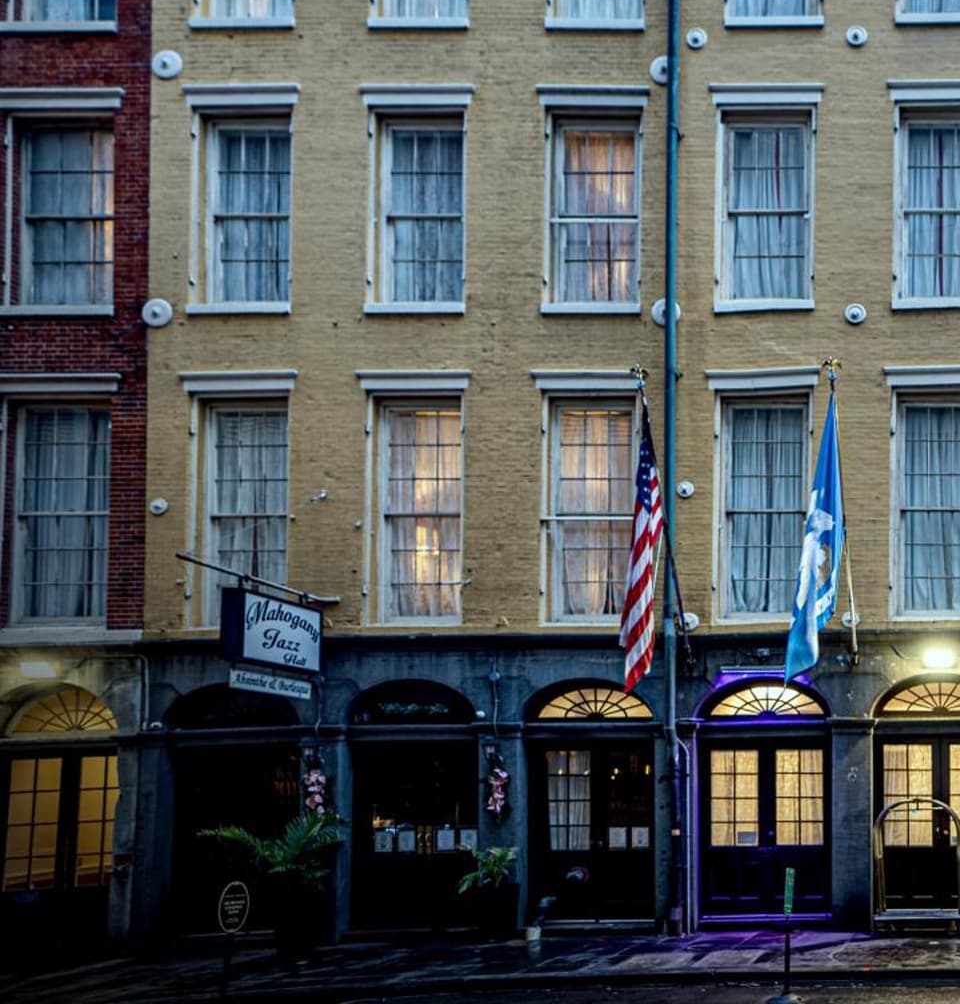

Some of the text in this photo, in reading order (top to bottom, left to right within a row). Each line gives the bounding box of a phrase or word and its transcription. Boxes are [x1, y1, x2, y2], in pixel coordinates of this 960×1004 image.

[246, 599, 320, 644] Mahogany
[262, 628, 301, 652] Jazz
[283, 652, 307, 666] Hall
